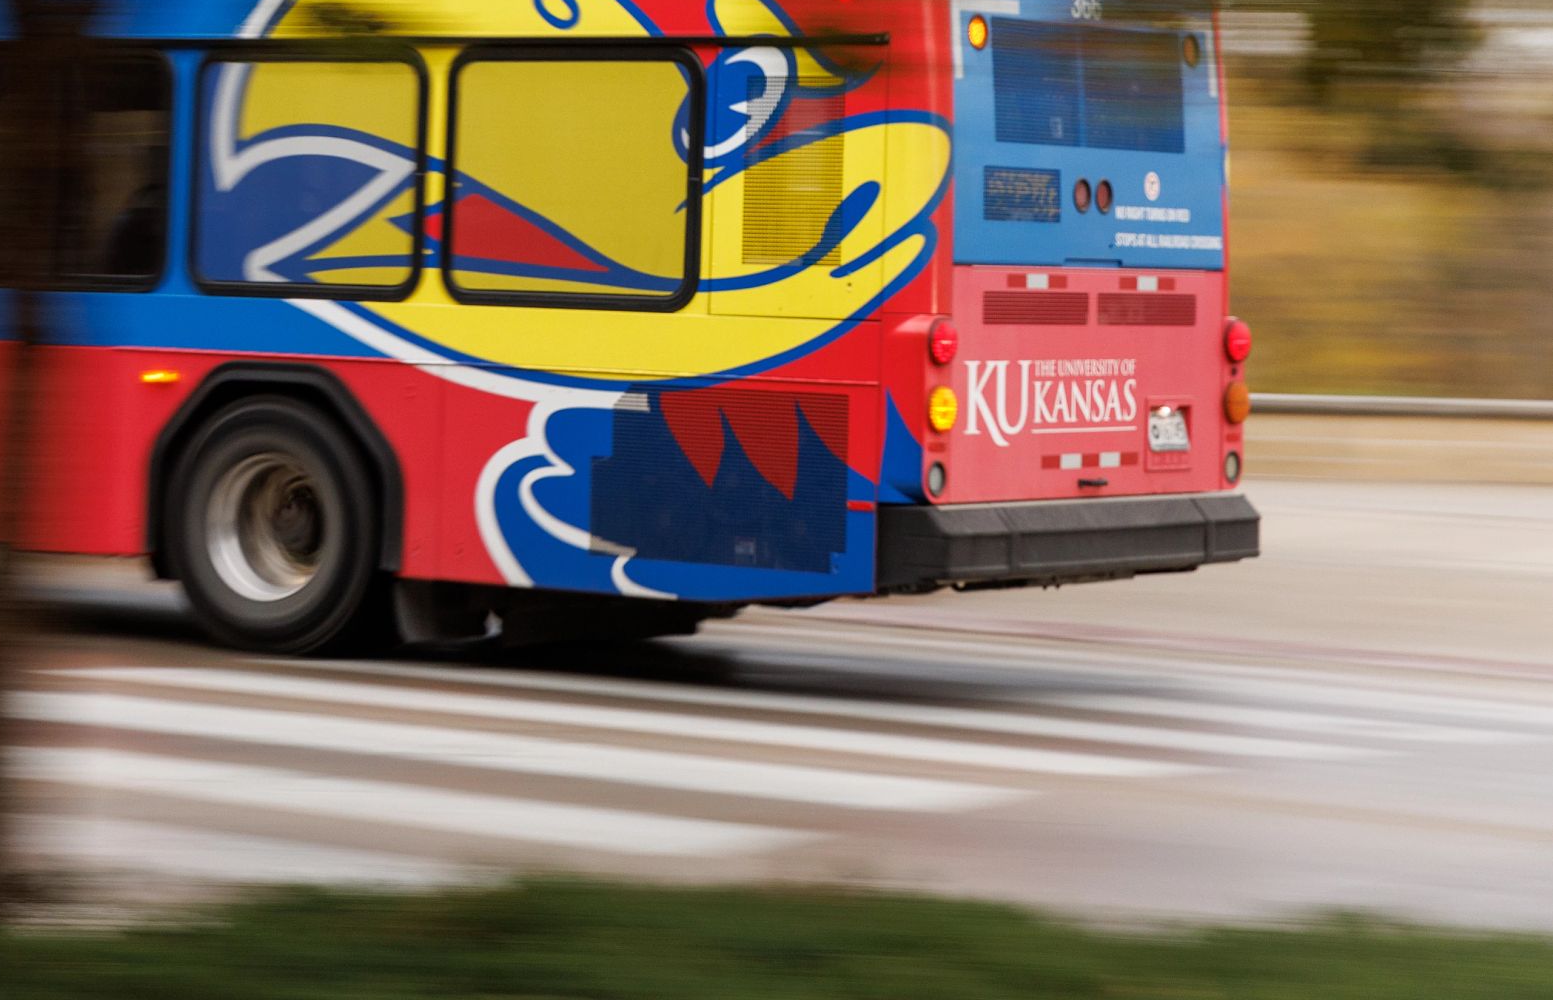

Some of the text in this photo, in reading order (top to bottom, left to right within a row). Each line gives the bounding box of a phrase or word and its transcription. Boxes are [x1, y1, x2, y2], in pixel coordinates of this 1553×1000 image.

[1034, 358, 1136, 377] THE UNIVERSITY OF
[963, 360, 1032, 446] KU
[1032, 379, 1137, 423] KANSAS
